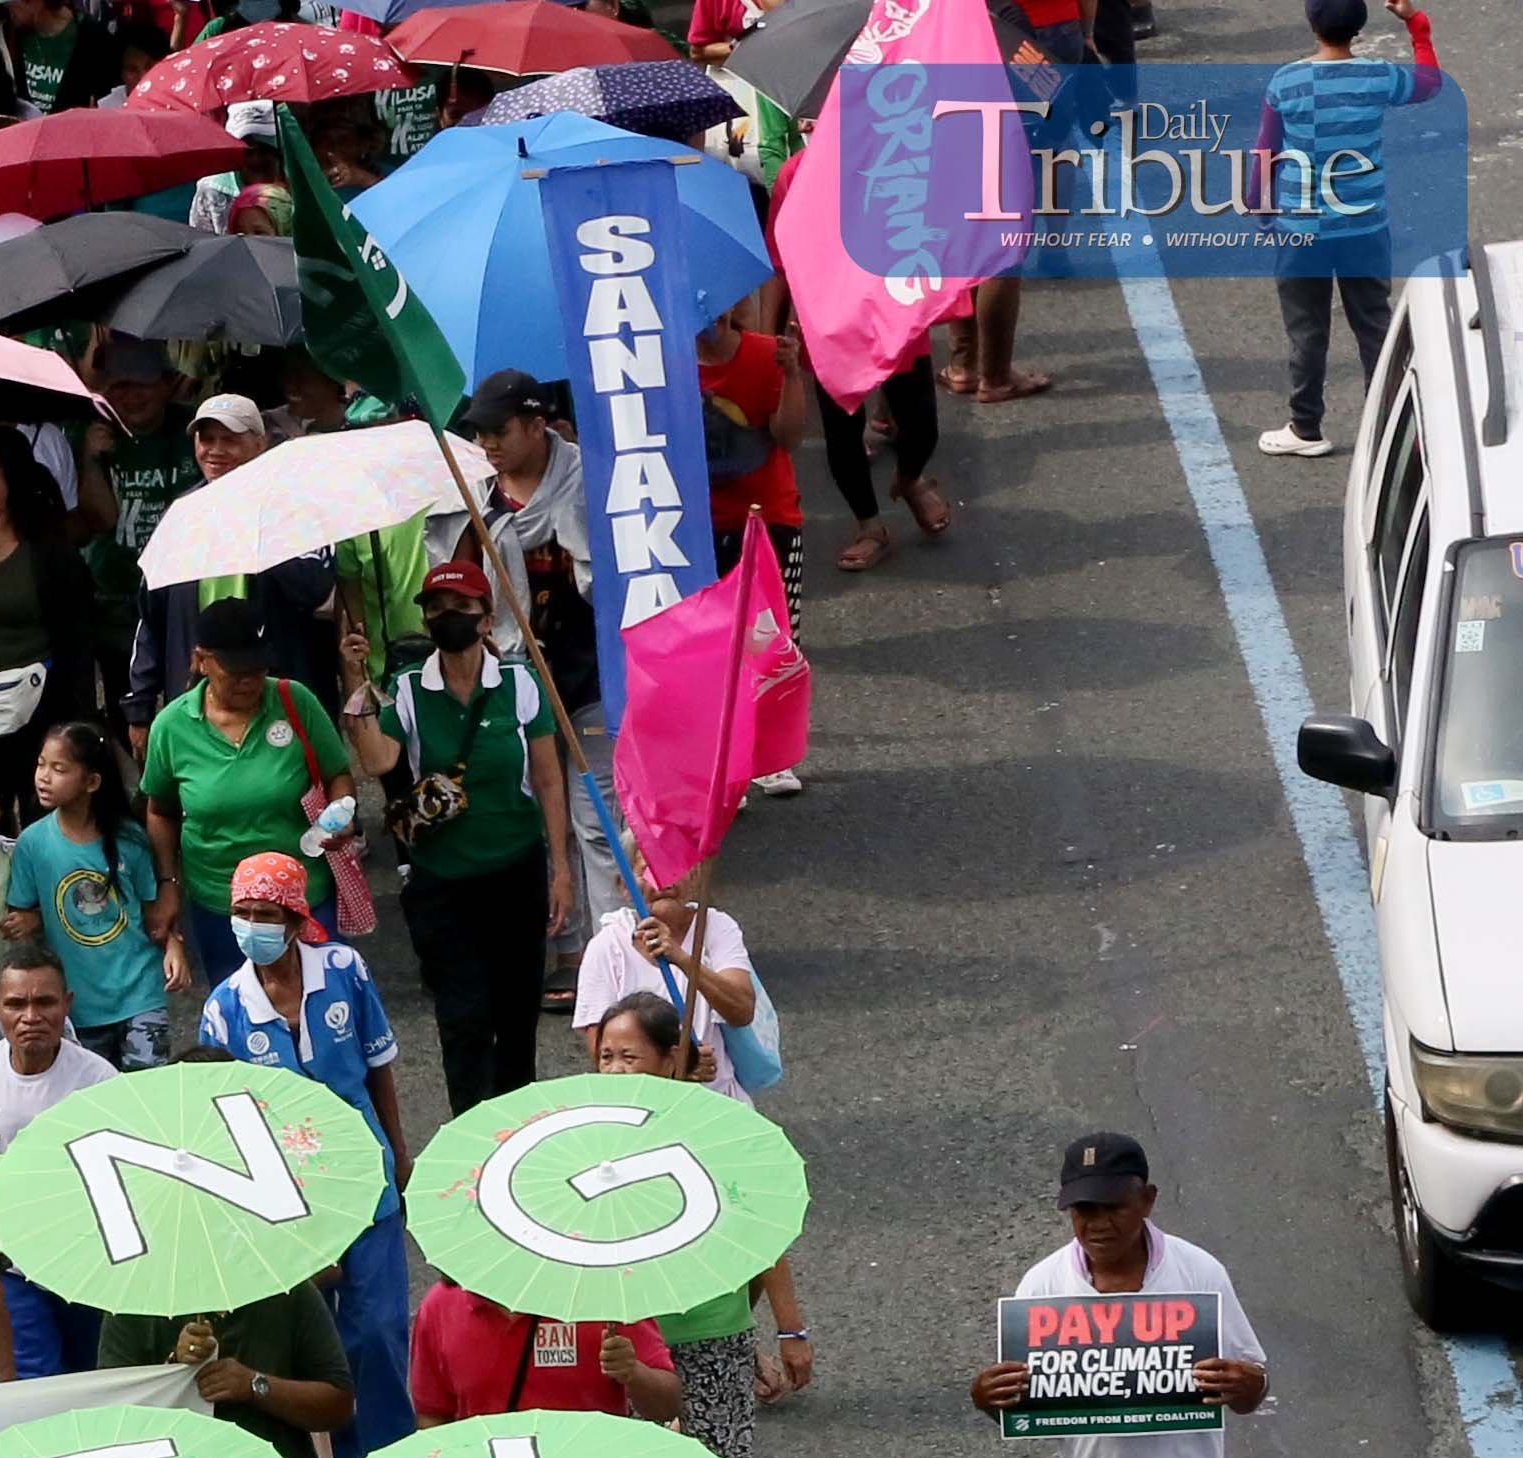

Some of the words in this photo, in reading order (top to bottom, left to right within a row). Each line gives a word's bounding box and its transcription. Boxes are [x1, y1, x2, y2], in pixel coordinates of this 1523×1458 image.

[537, 1326, 574, 1347] BAN
[1028, 1303, 1124, 1347] PAY
[1131, 1301, 1196, 1342] UP
[537, 1350, 575, 1364] TOXICS
[1027, 1350, 1078, 1375] FOR
[1081, 1345, 1195, 1373] CLIMATE
[1030, 1372, 1131, 1399] INANCE,
[1136, 1369, 1197, 1394] NOW
[1036, 1416, 1088, 1427] FREEDOM
[1091, 1415, 1121, 1425] FROM
[1124, 1414, 1152, 1424] DEBT
[1156, 1411, 1215, 1422] COALITION
